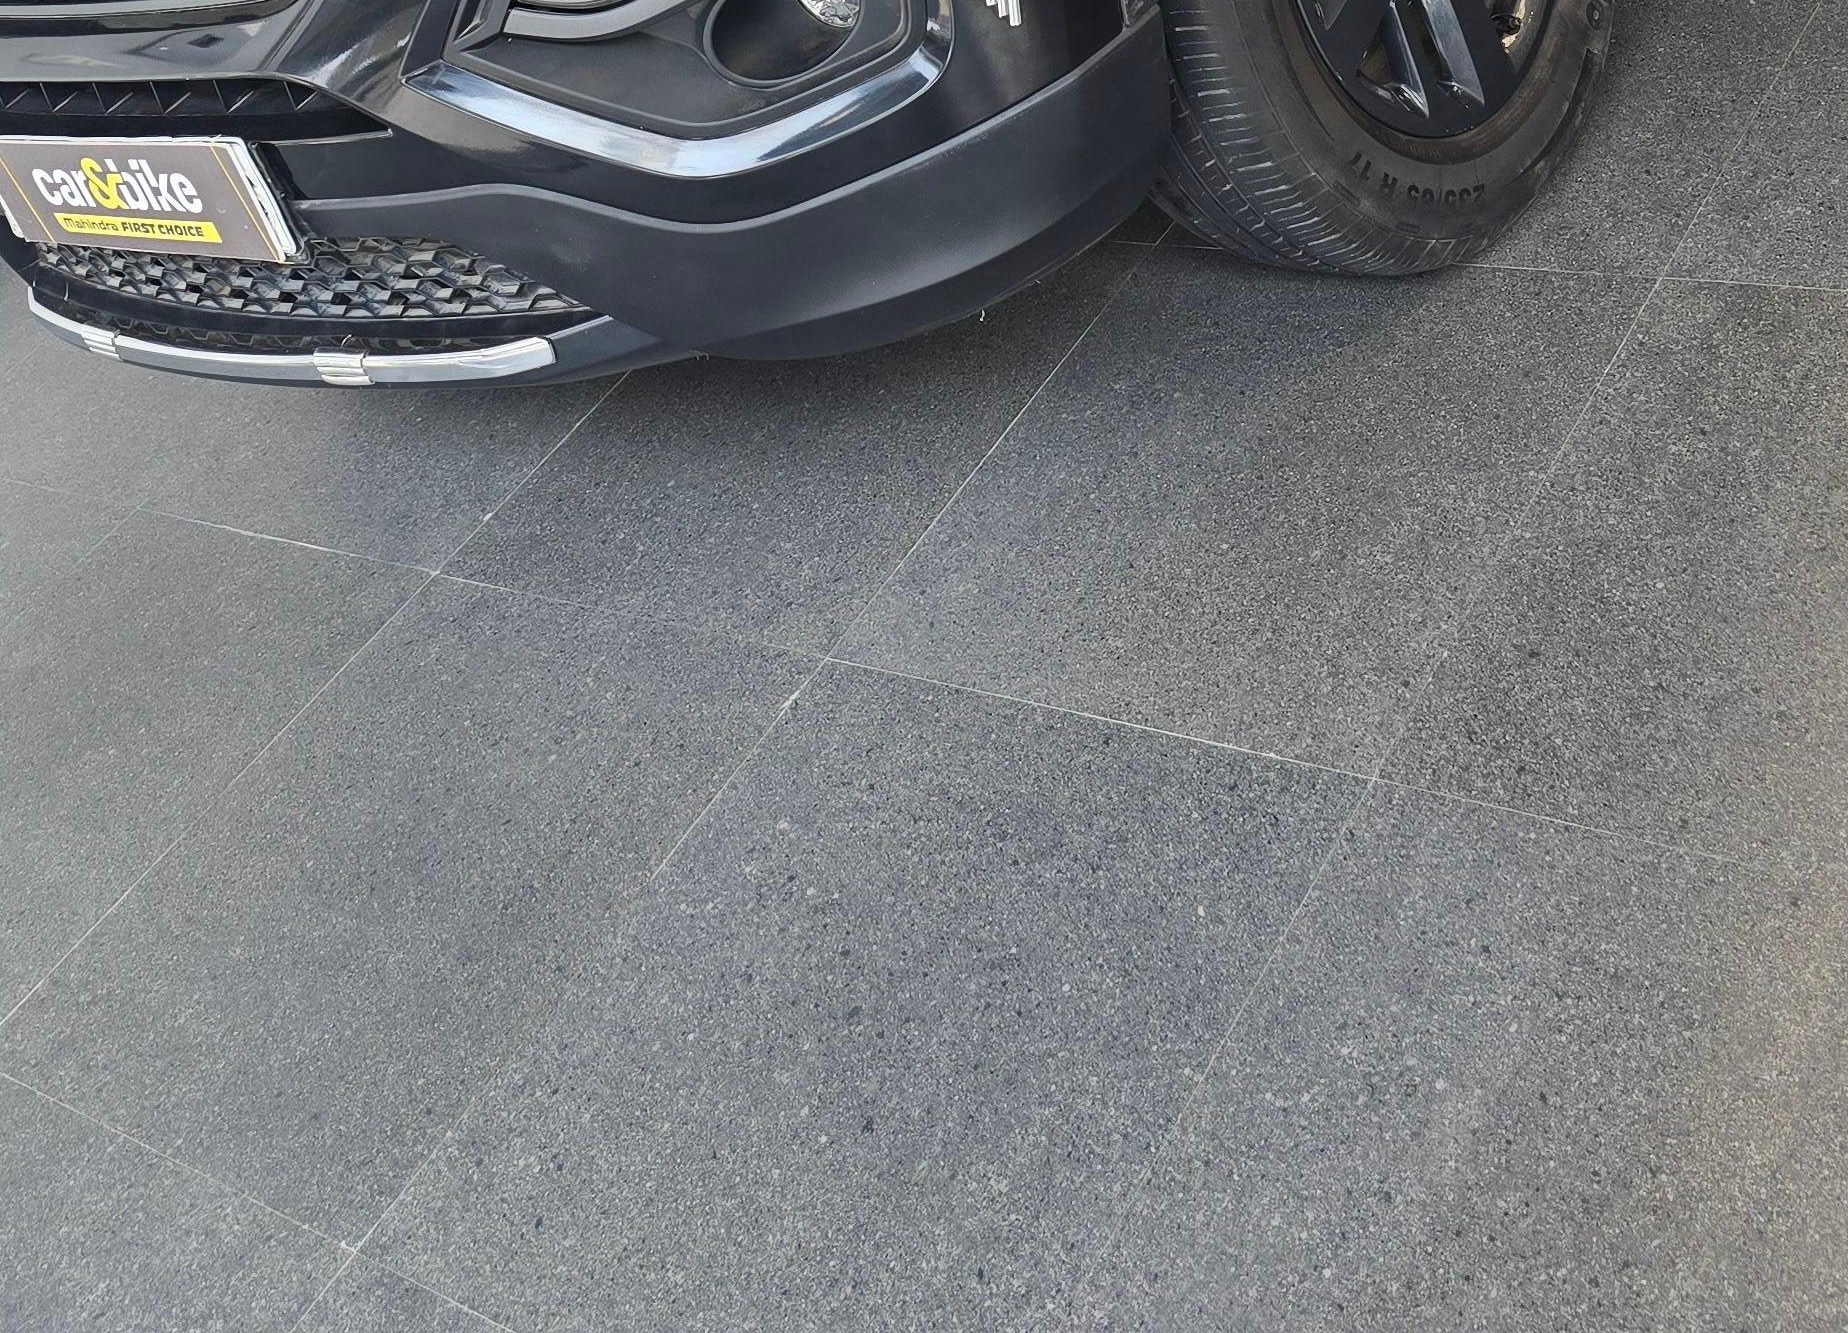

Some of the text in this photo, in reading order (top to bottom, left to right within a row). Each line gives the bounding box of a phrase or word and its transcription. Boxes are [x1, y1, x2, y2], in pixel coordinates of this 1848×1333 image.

[32, 157, 203, 214] car&bike
[62, 217, 205, 237] Mahindra FIRST CHOICE
